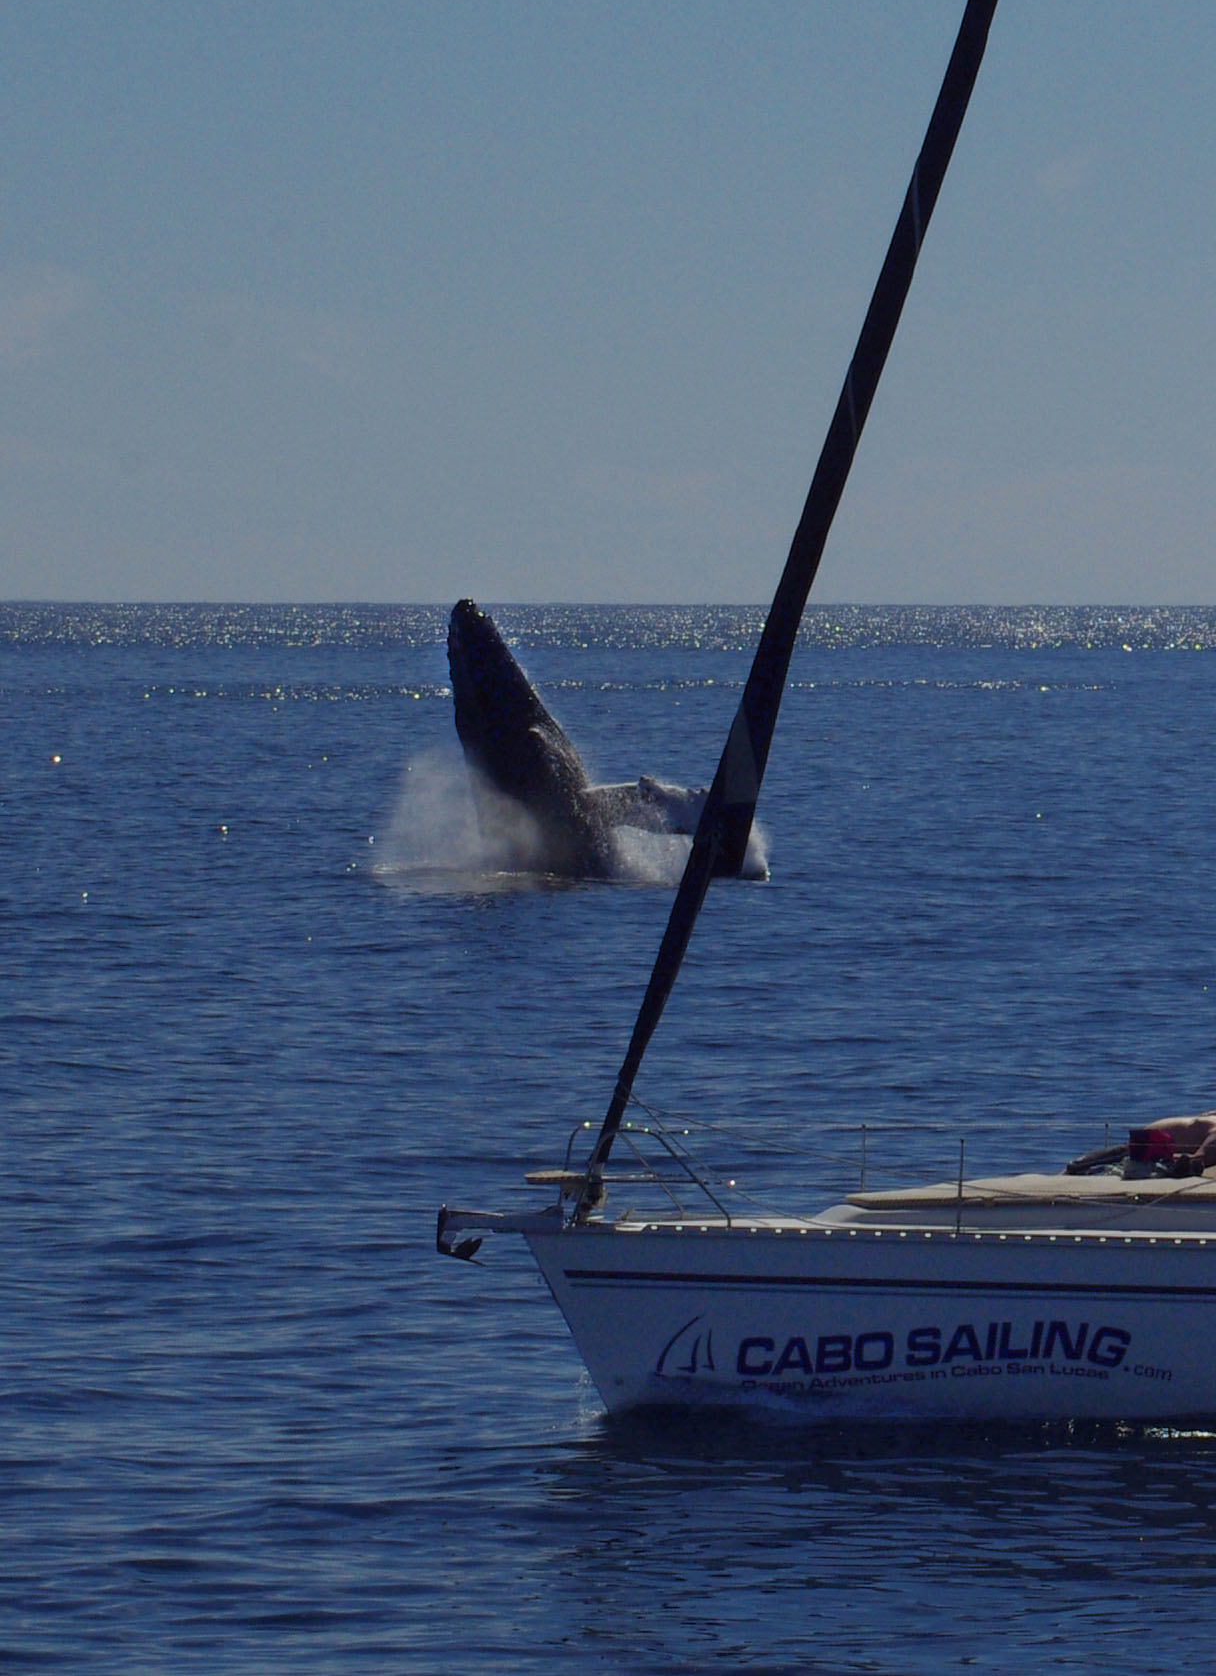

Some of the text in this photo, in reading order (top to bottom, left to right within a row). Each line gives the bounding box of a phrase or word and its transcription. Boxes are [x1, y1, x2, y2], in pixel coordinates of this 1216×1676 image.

[736, 1331, 894, 1376] CABO
[905, 1320, 1132, 1369] SAILING
[808, 1370, 926, 1389] Adventures
[930, 1369, 947, 1380] in
[951, 1363, 1003, 1378] Cabo
[1006, 1362, 1045, 1376] San
[1050, 1363, 1110, 1380] Lucas
